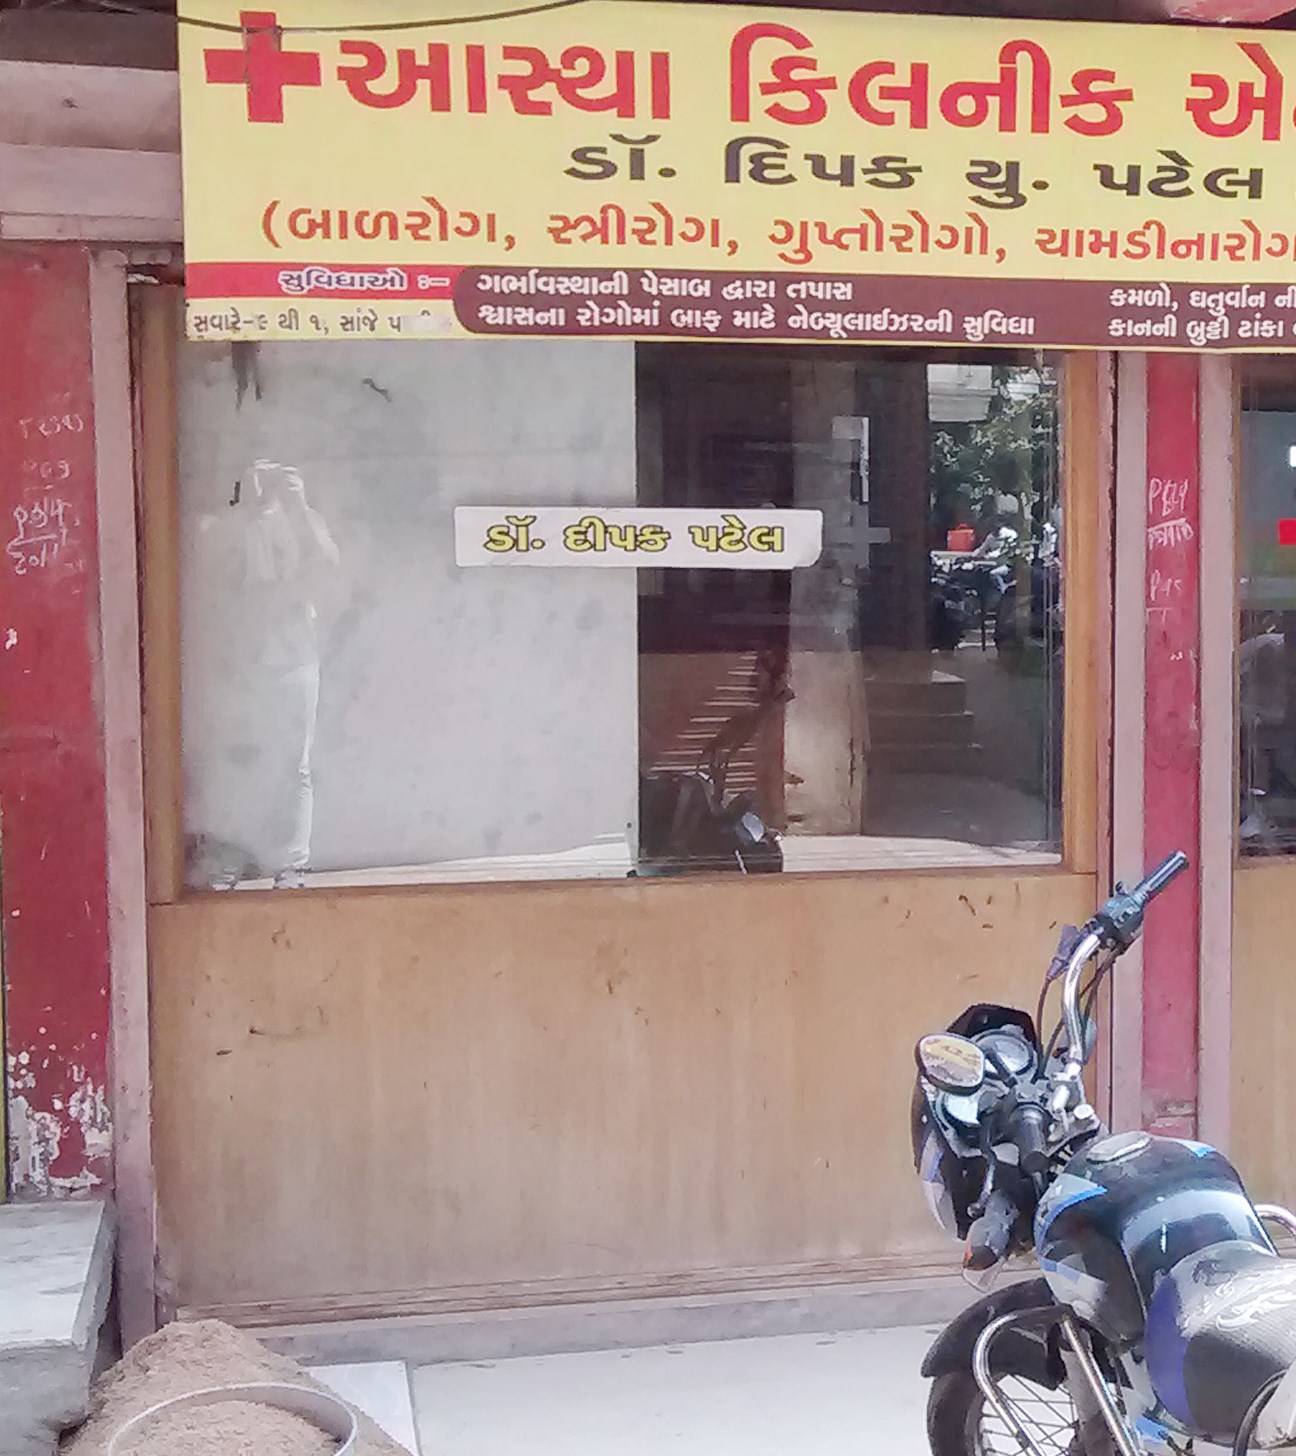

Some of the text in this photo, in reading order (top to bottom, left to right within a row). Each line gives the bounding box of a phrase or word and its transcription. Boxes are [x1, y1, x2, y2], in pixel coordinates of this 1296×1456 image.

[337, 39, 670, 120] આસ્થા
[724, 135, 922, 190] દિપક
[965, 158, 1050, 210] યુ.
[1093, 149, 1264, 200] પટેલ
[261, 196, 516, 252] (બાળરોગ,
[546, 201, 739, 257] સ્ત્રીરોગ,
[278, 267, 408, 294] સુવિધાઓ
[477, 269, 853, 301] ગર્ભાવસ્થાની પેસાબ દ્વારા તપાસ
[1109, 283, 1179, 312] કમળો,
[278, 308, 300, 331] થી
[338, 307, 379, 332] સાંજે
[478, 303, 566, 327] શ્વાસના
[576, 300, 659, 327] રોગોમાં
[670, 307, 722, 332] બાફ
[733, 303, 776, 329] માટે
[962, 309, 1035, 342] સુવિધા
[1108, 314, 1177, 337] કાનની
[1237, 312, 1284, 338] ટાંકા
[563, 516, 672, 553] દીપક
[688, 514, 785, 553] પટેલ
